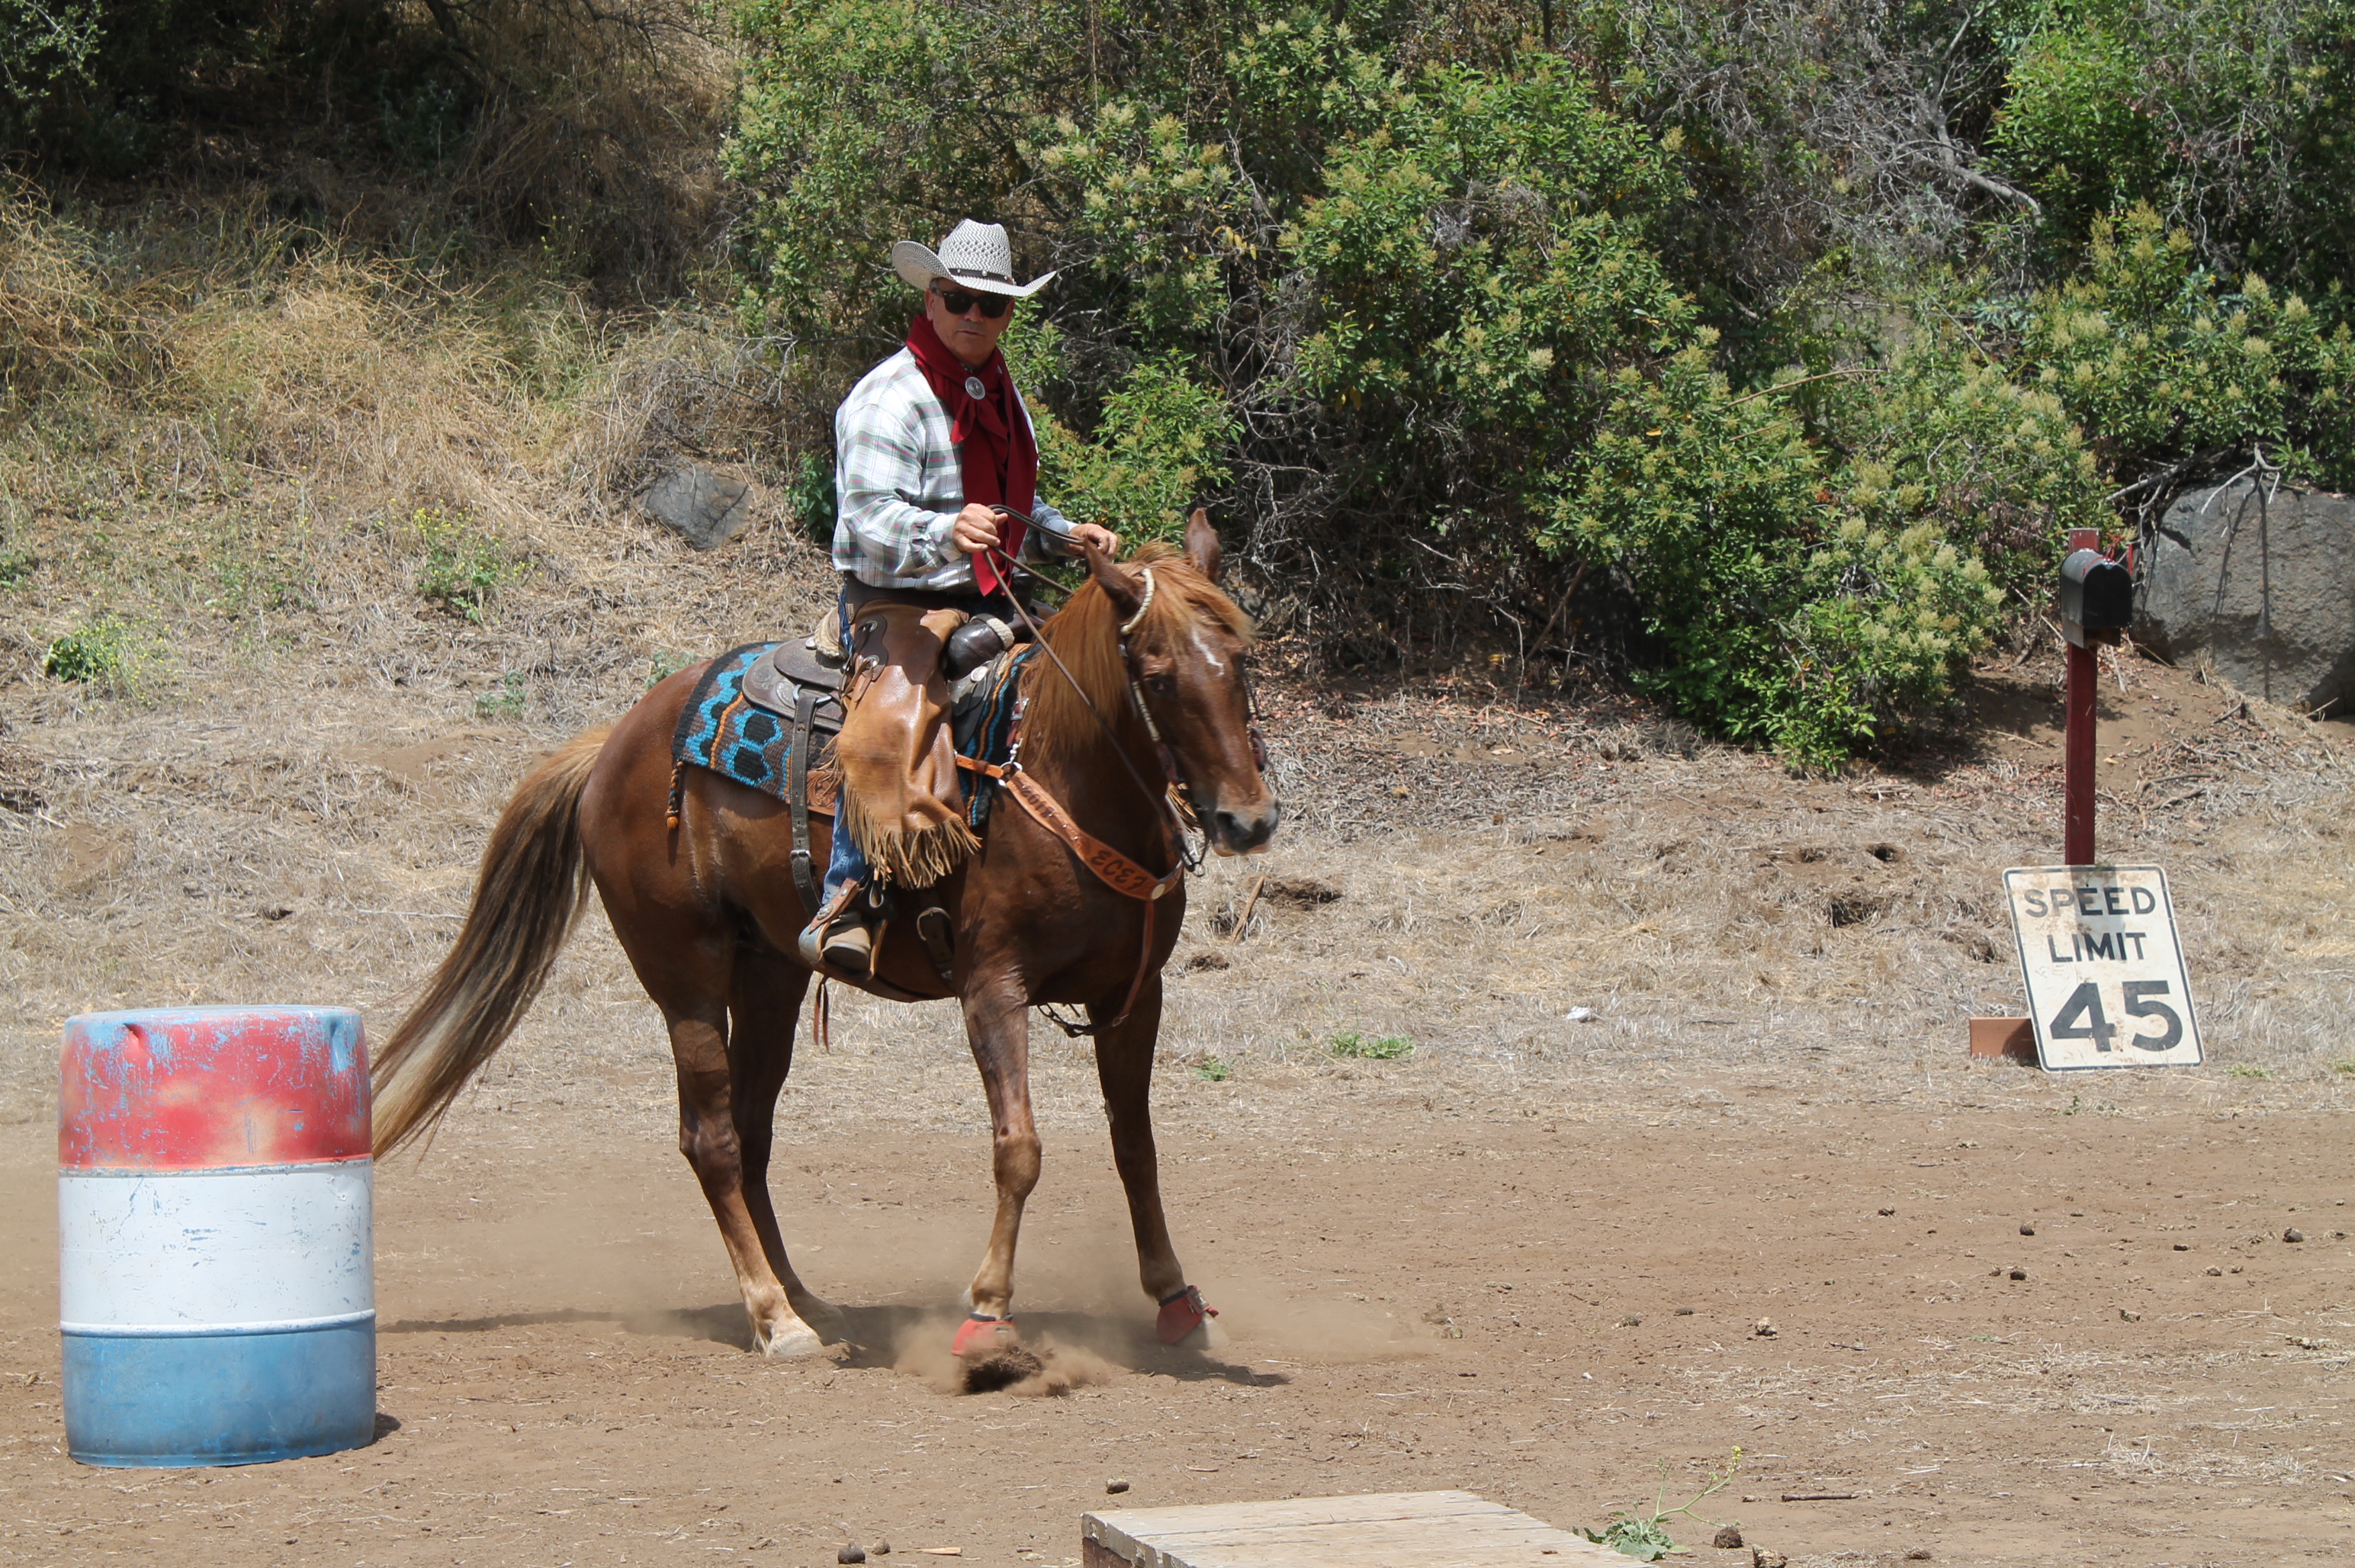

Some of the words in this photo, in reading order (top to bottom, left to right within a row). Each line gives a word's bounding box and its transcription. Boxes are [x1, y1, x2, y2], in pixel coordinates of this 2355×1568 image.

[2024, 887, 2156, 917] SPEED
[2047, 932, 2147, 962] LIMIT
[2050, 980, 2183, 1052] 45
